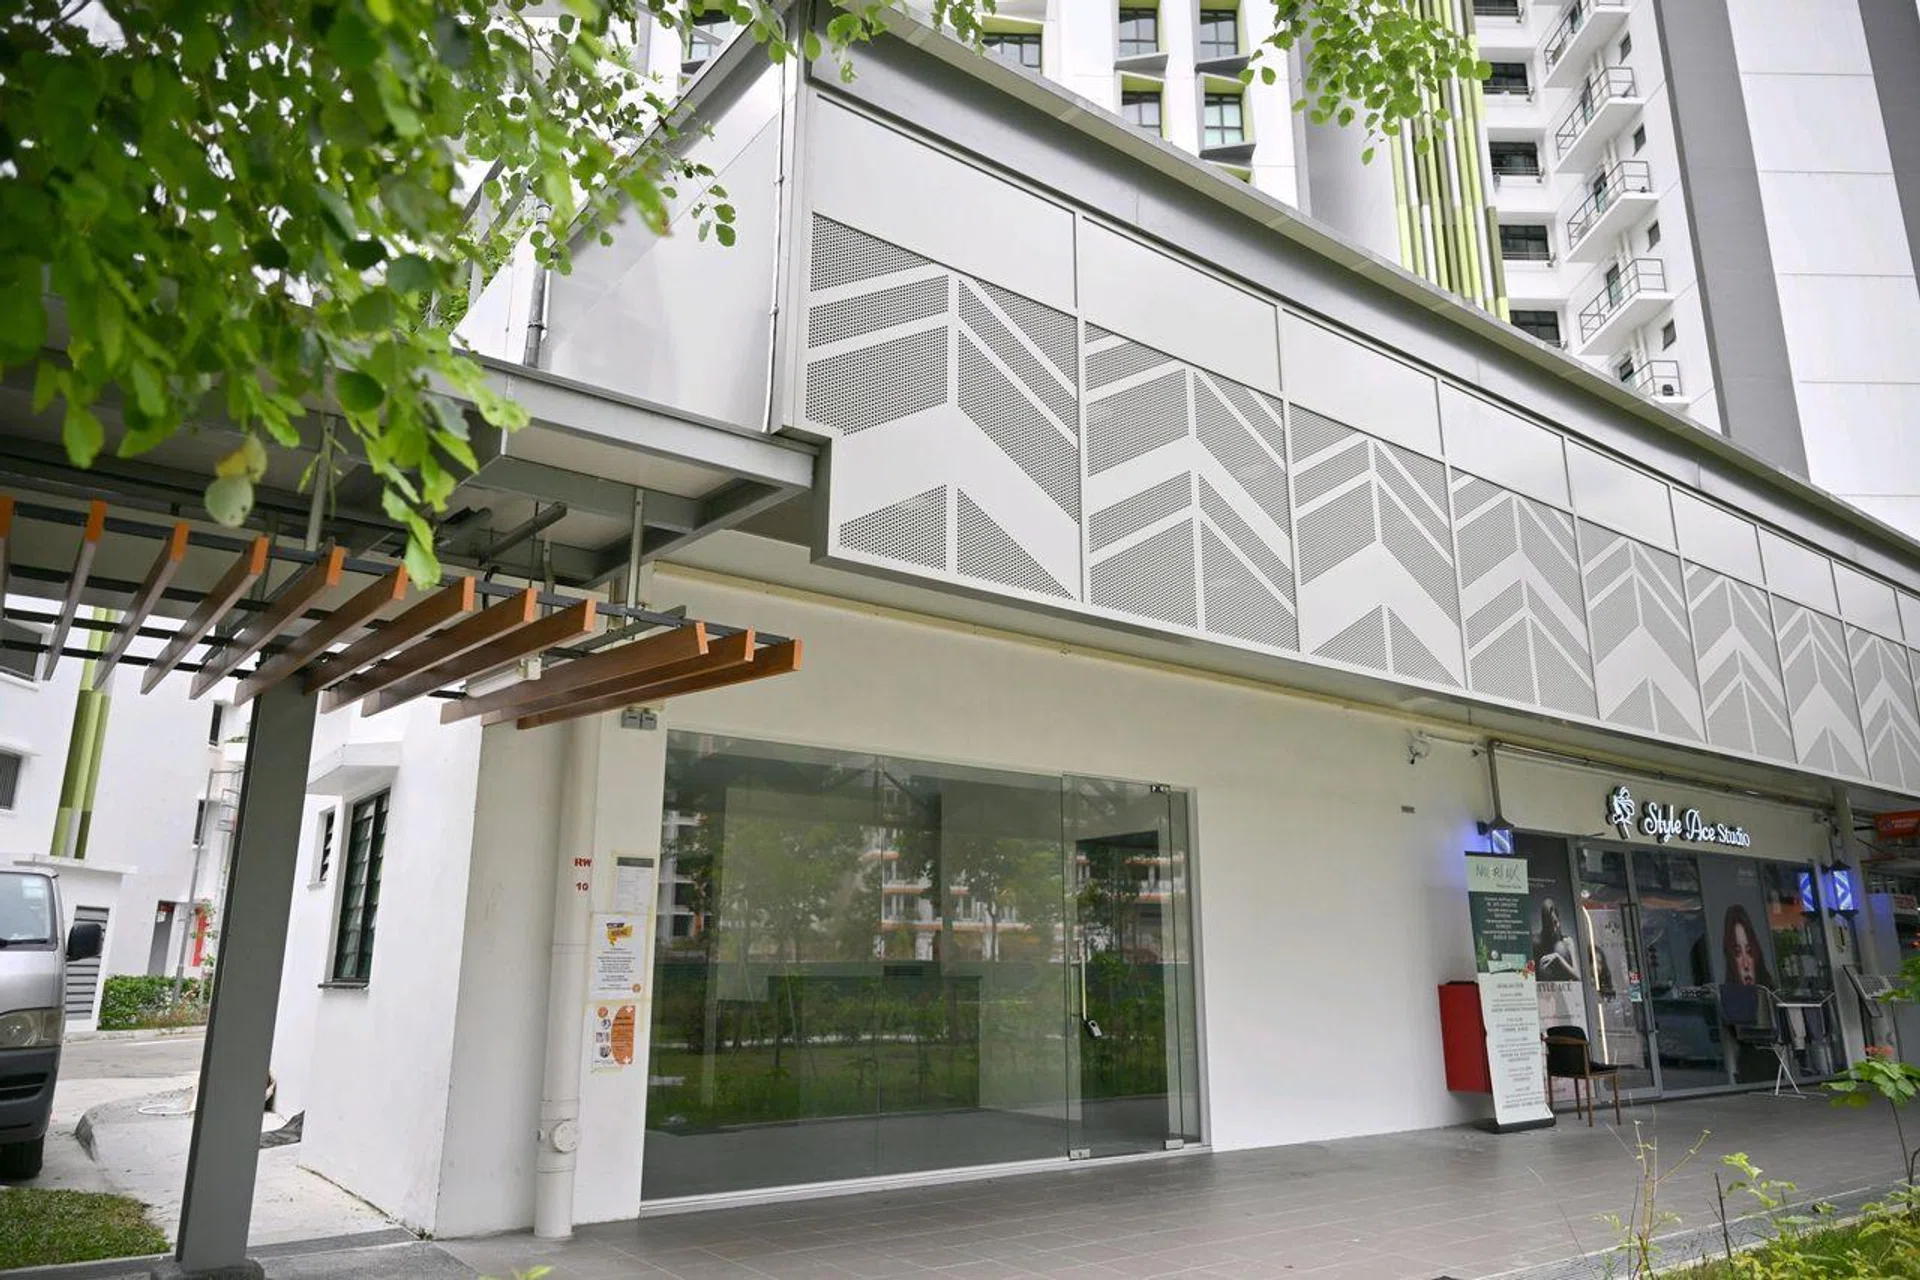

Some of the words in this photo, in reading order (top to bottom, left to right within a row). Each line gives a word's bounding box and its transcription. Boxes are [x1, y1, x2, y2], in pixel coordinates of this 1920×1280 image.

[1645, 802, 1682, 843] Style
[1686, 808, 1715, 842] Ace
[1717, 823, 1751, 848] Studio
[574, 857, 592, 867] RW
[576, 882, 589, 891] 10
